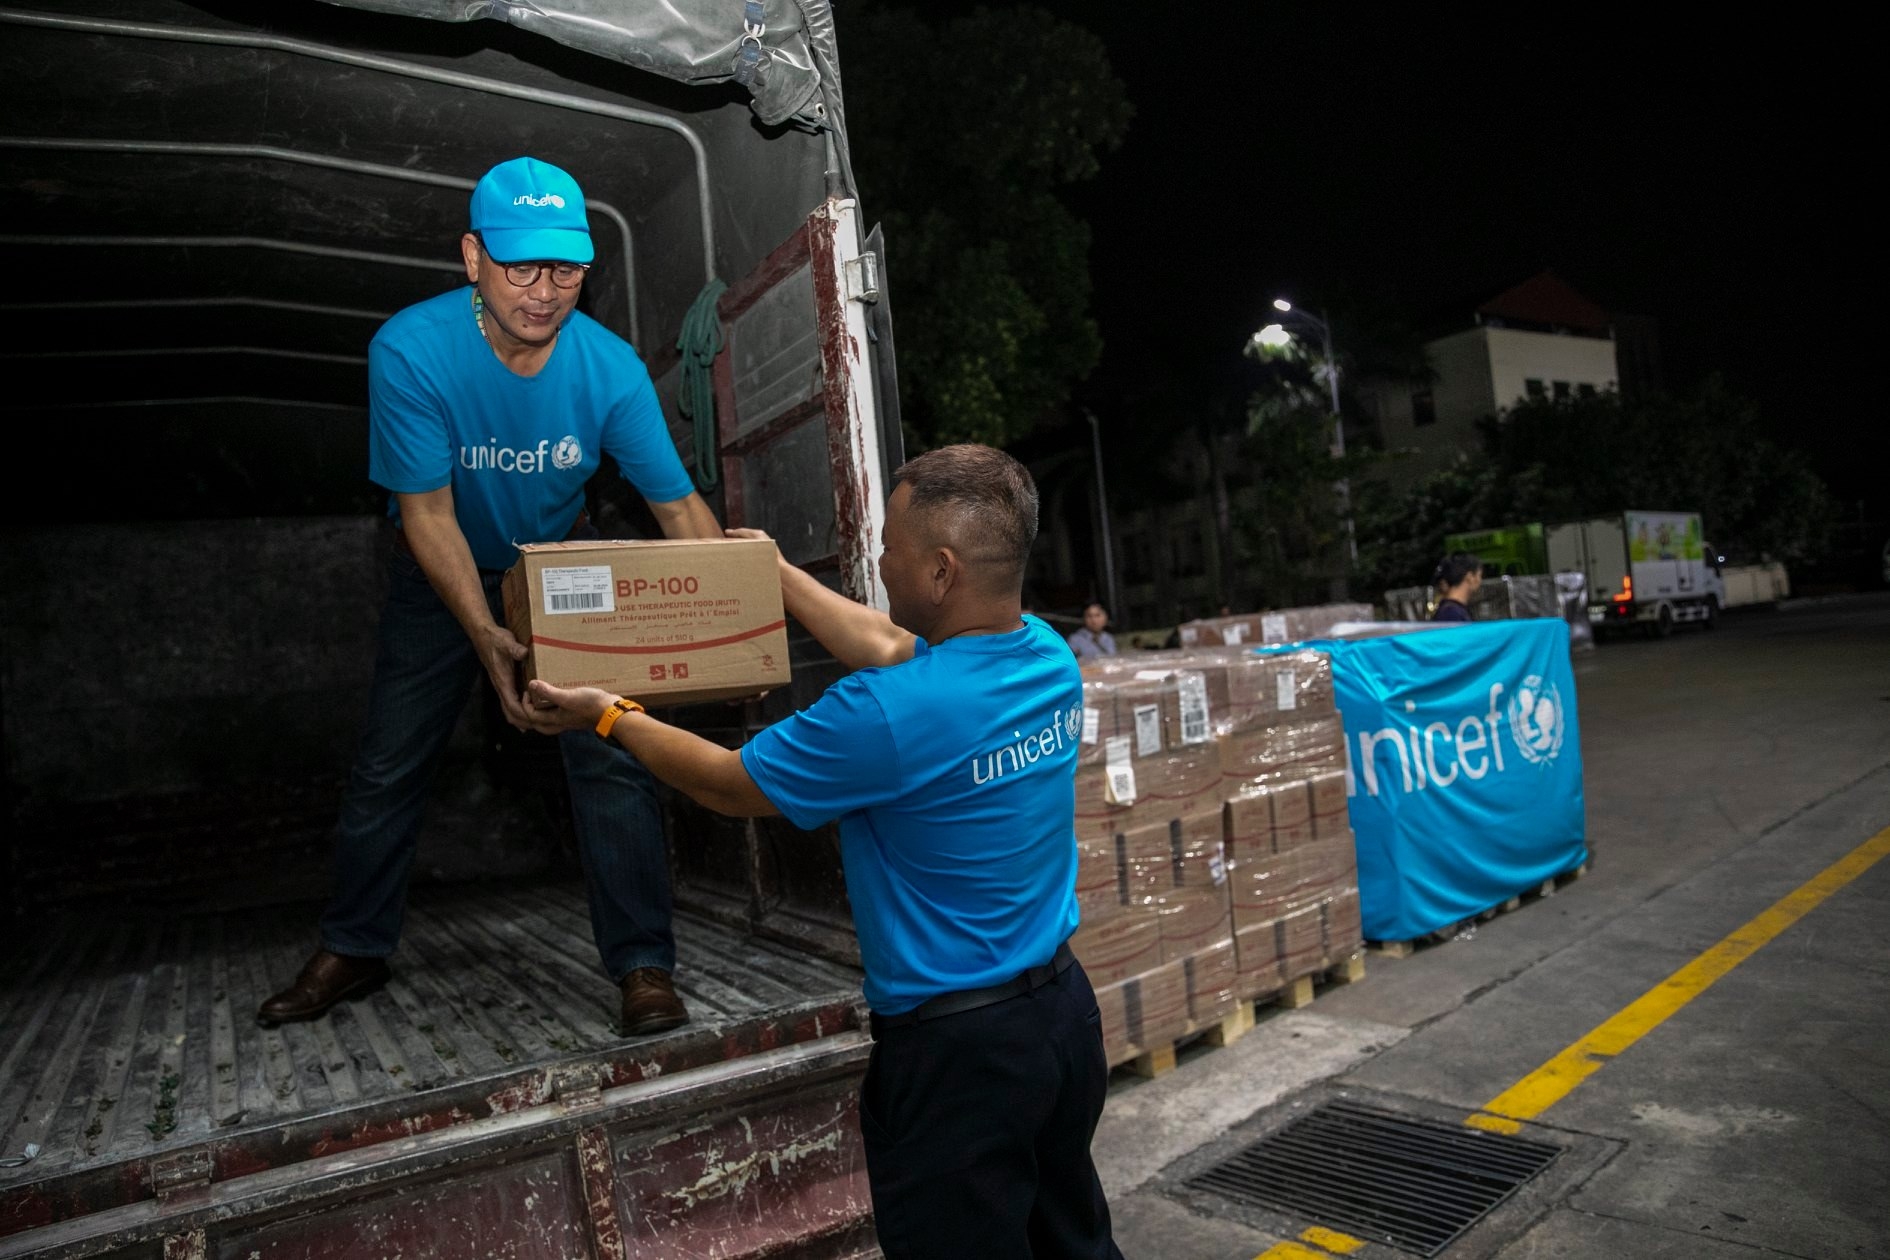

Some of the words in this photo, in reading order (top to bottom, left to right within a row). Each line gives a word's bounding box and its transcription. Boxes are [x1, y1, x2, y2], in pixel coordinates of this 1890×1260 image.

[513, 193, 552, 207] unicef
[460, 437, 549, 473] unicef
[616, 576, 699, 598] BP-100
[620, 604, 636, 612] USE
[638, 601, 692, 611] THERAPEUTIC
[693, 599, 714, 608] FOOD
[715, 598, 741, 607] (RUTF)
[620, 611, 677, 622] Thérapeutique
[635, 636, 645, 644] 24
[646, 634, 665, 643] units
[675, 633, 688, 641] 510
[588, 678, 617, 686] COMPACT
[972, 709, 1063, 785] unicef
